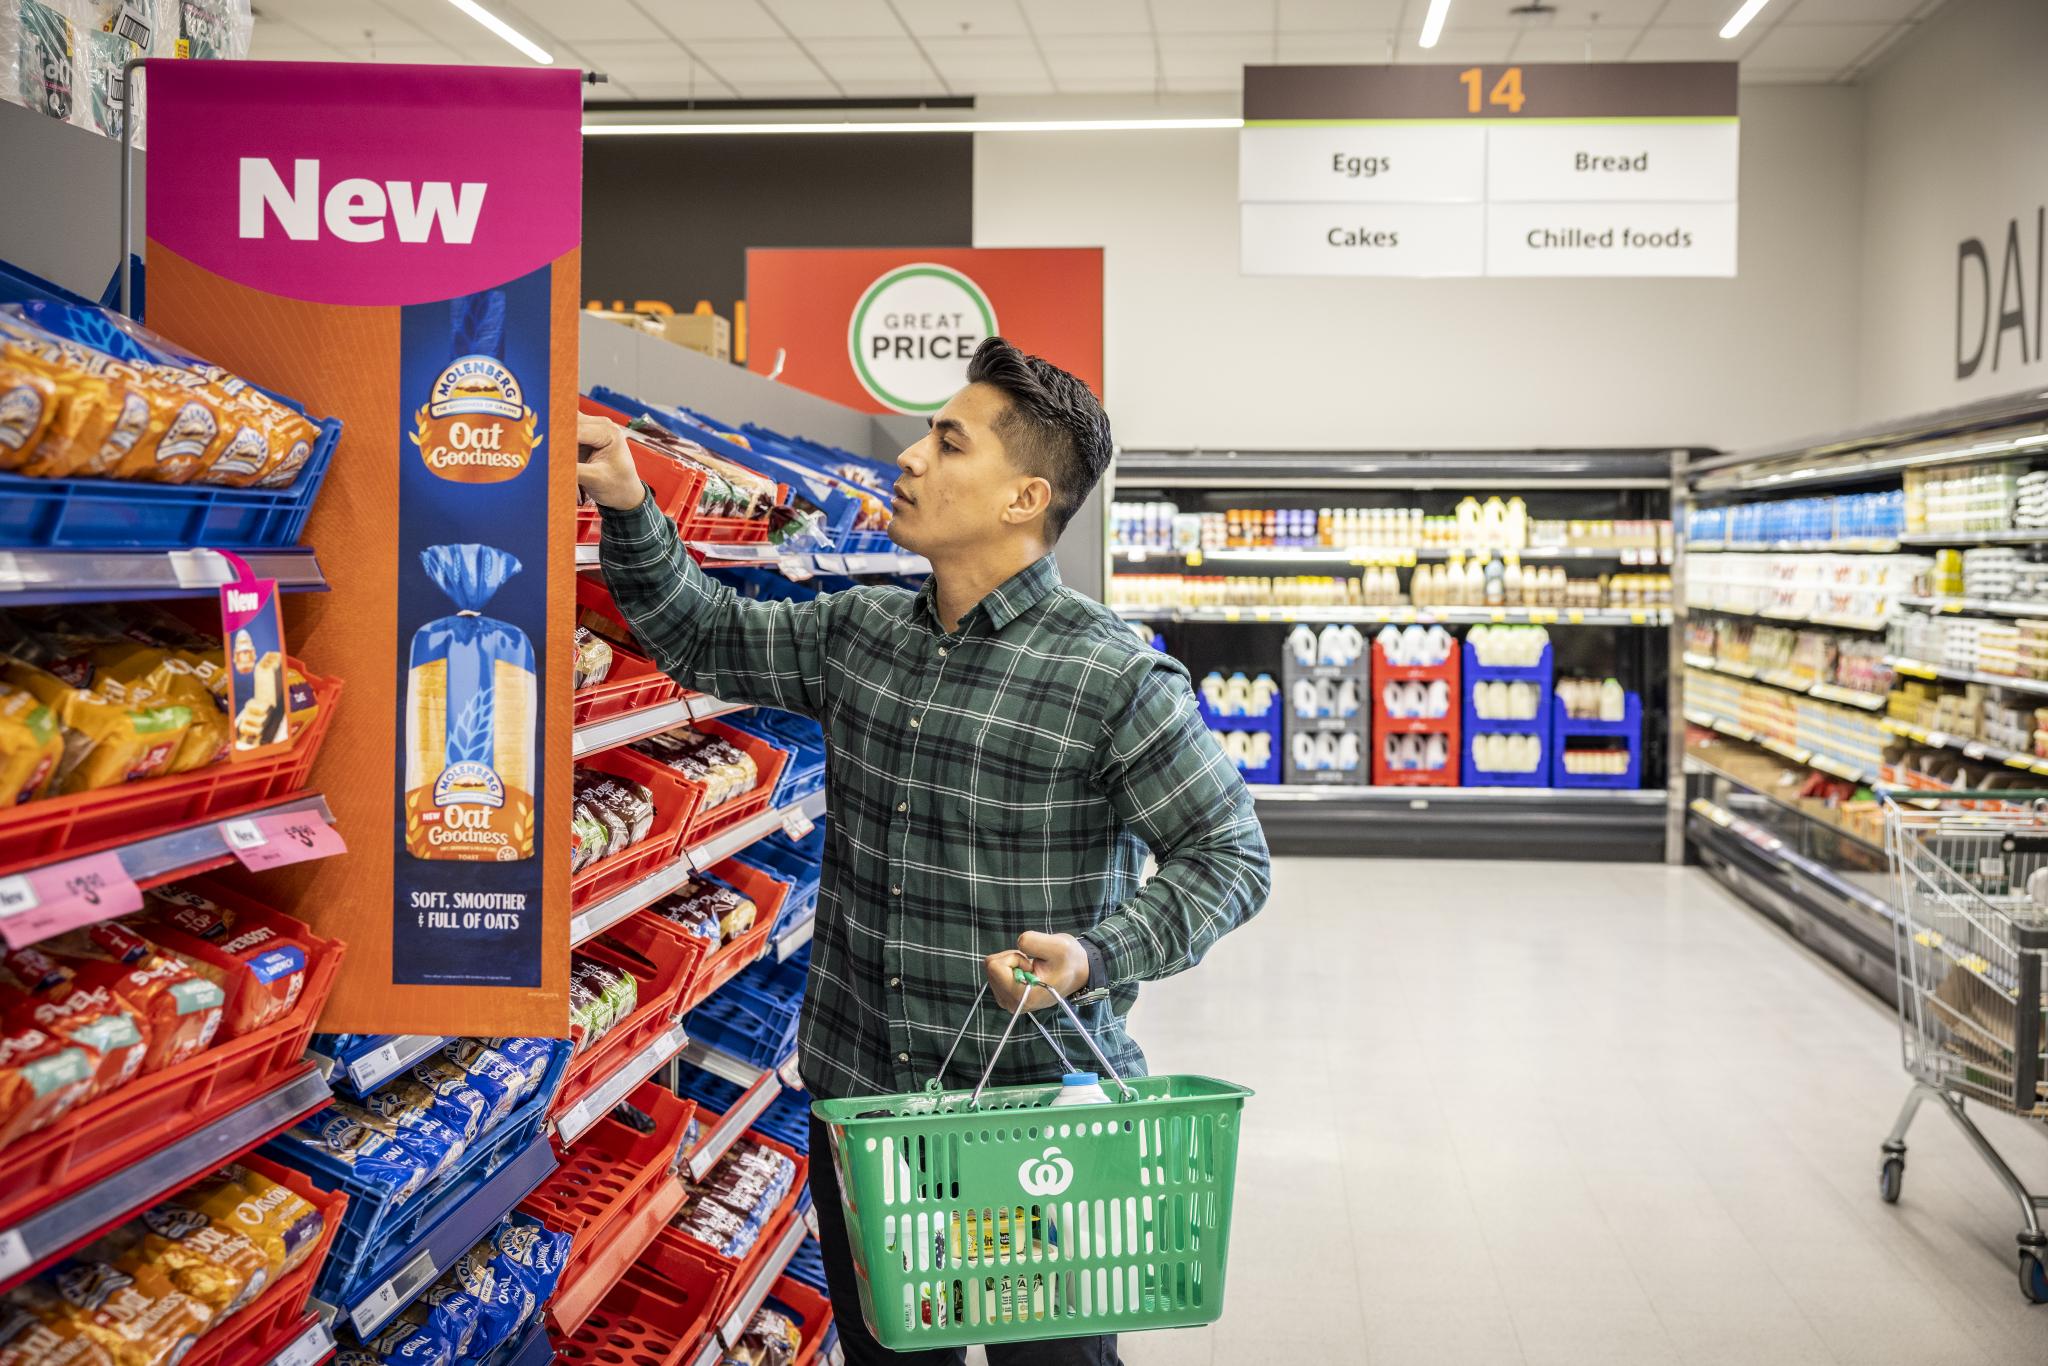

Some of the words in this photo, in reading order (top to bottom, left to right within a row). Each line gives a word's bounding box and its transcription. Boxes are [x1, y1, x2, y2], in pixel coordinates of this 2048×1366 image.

[1459, 68, 1525, 113] 14
[1332, 152, 1390, 177] Eggs
[1574, 151, 1649, 173] Bread
[239, 157, 488, 244] New
[1327, 227, 1399, 248] Cakes
[1526, 228, 1615, 249] Chilled
[1622, 228, 1692, 249] foods
[884, 313, 963, 330] GREAT
[873, 336, 975, 359] PRICE
[437, 362, 518, 399] MOLENBERG
[448, 422, 504, 450] Oat
[431, 446, 521, 468] Goodness
[227, 590, 259, 613] New
[440, 765, 499, 792] MOLENBERG
[422, 811, 441, 821] NEW
[444, 804, 493, 829] Oat
[428, 826, 509, 845] Goodness
[410, 891, 450, 910] SOFT,
[453, 892, 526, 911] SMOOTHER
[174, 909, 196, 924] TIP
[184, 914, 211, 932] TOP
[428, 912, 460, 929] FULL
[463, 912, 482, 929] OF
[484, 913, 519, 930] OATS
